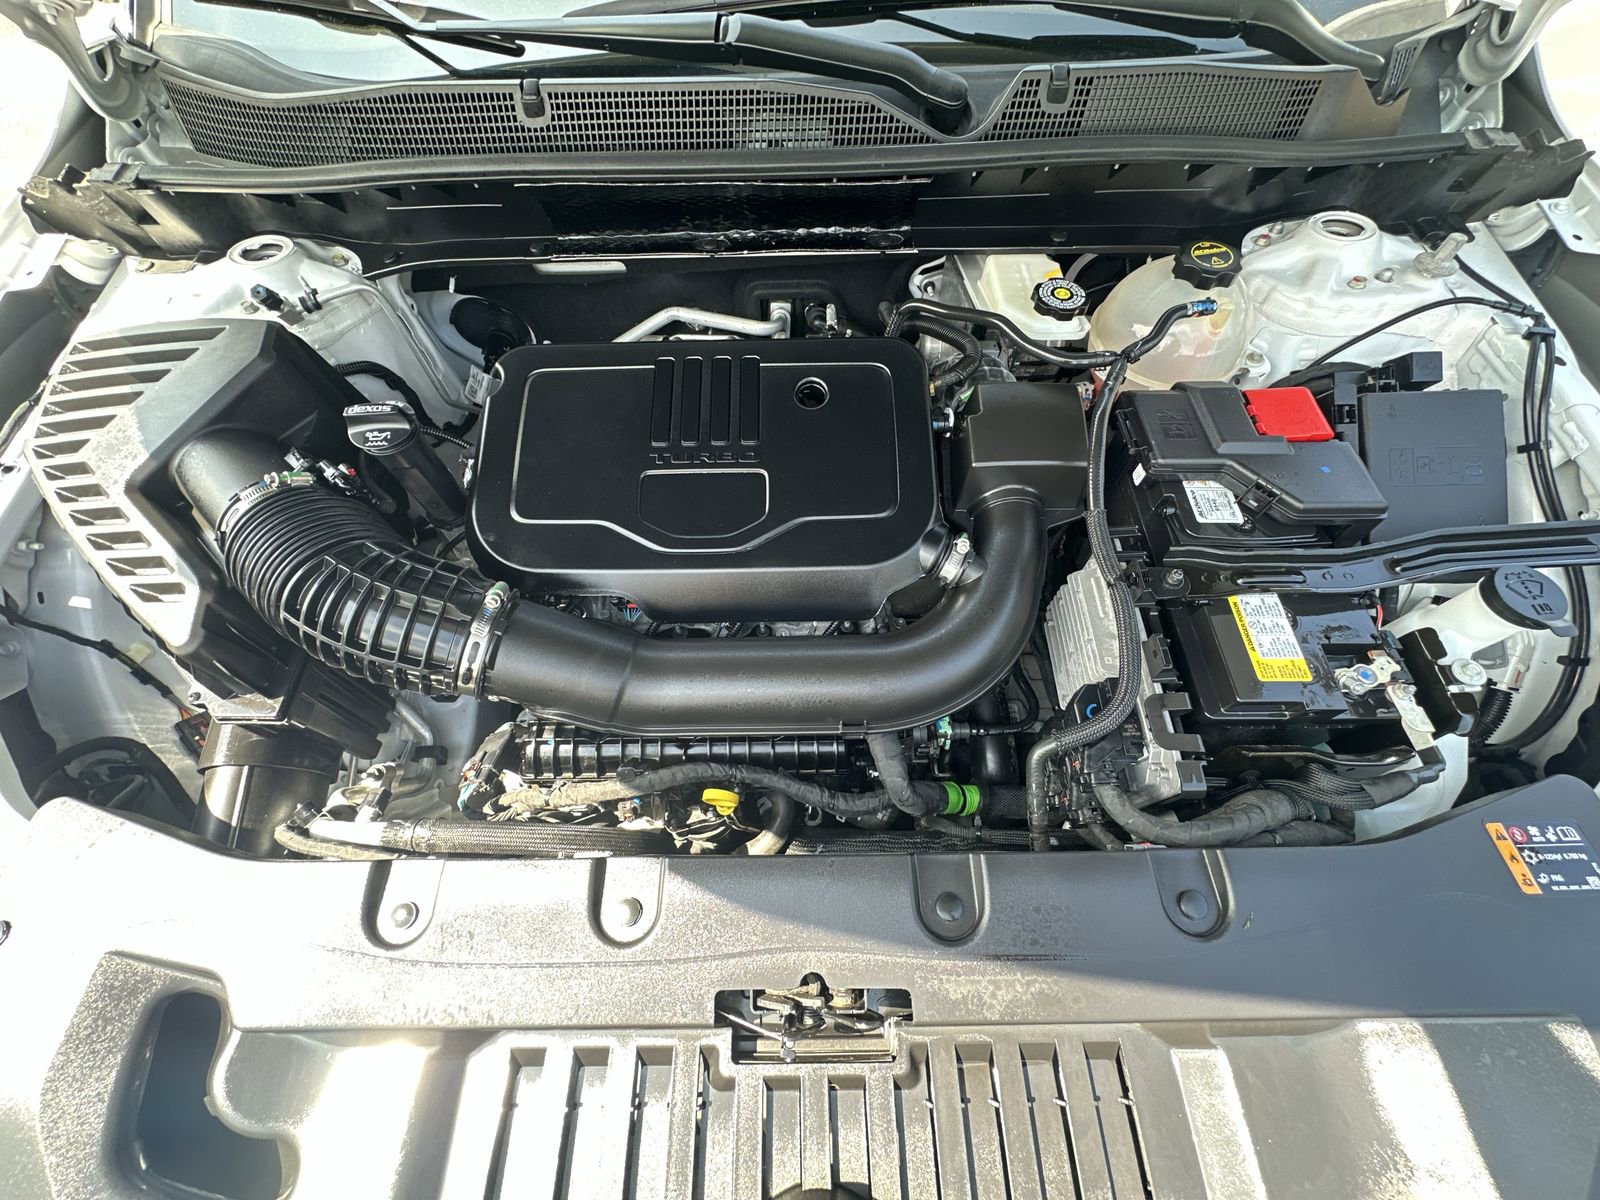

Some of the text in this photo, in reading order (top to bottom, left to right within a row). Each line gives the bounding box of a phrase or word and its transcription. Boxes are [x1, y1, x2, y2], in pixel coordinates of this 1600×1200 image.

[347, 404, 393, 414] dexos
[649, 452, 760, 464] TURBO
[1232, 601, 1245, 623] POISON
